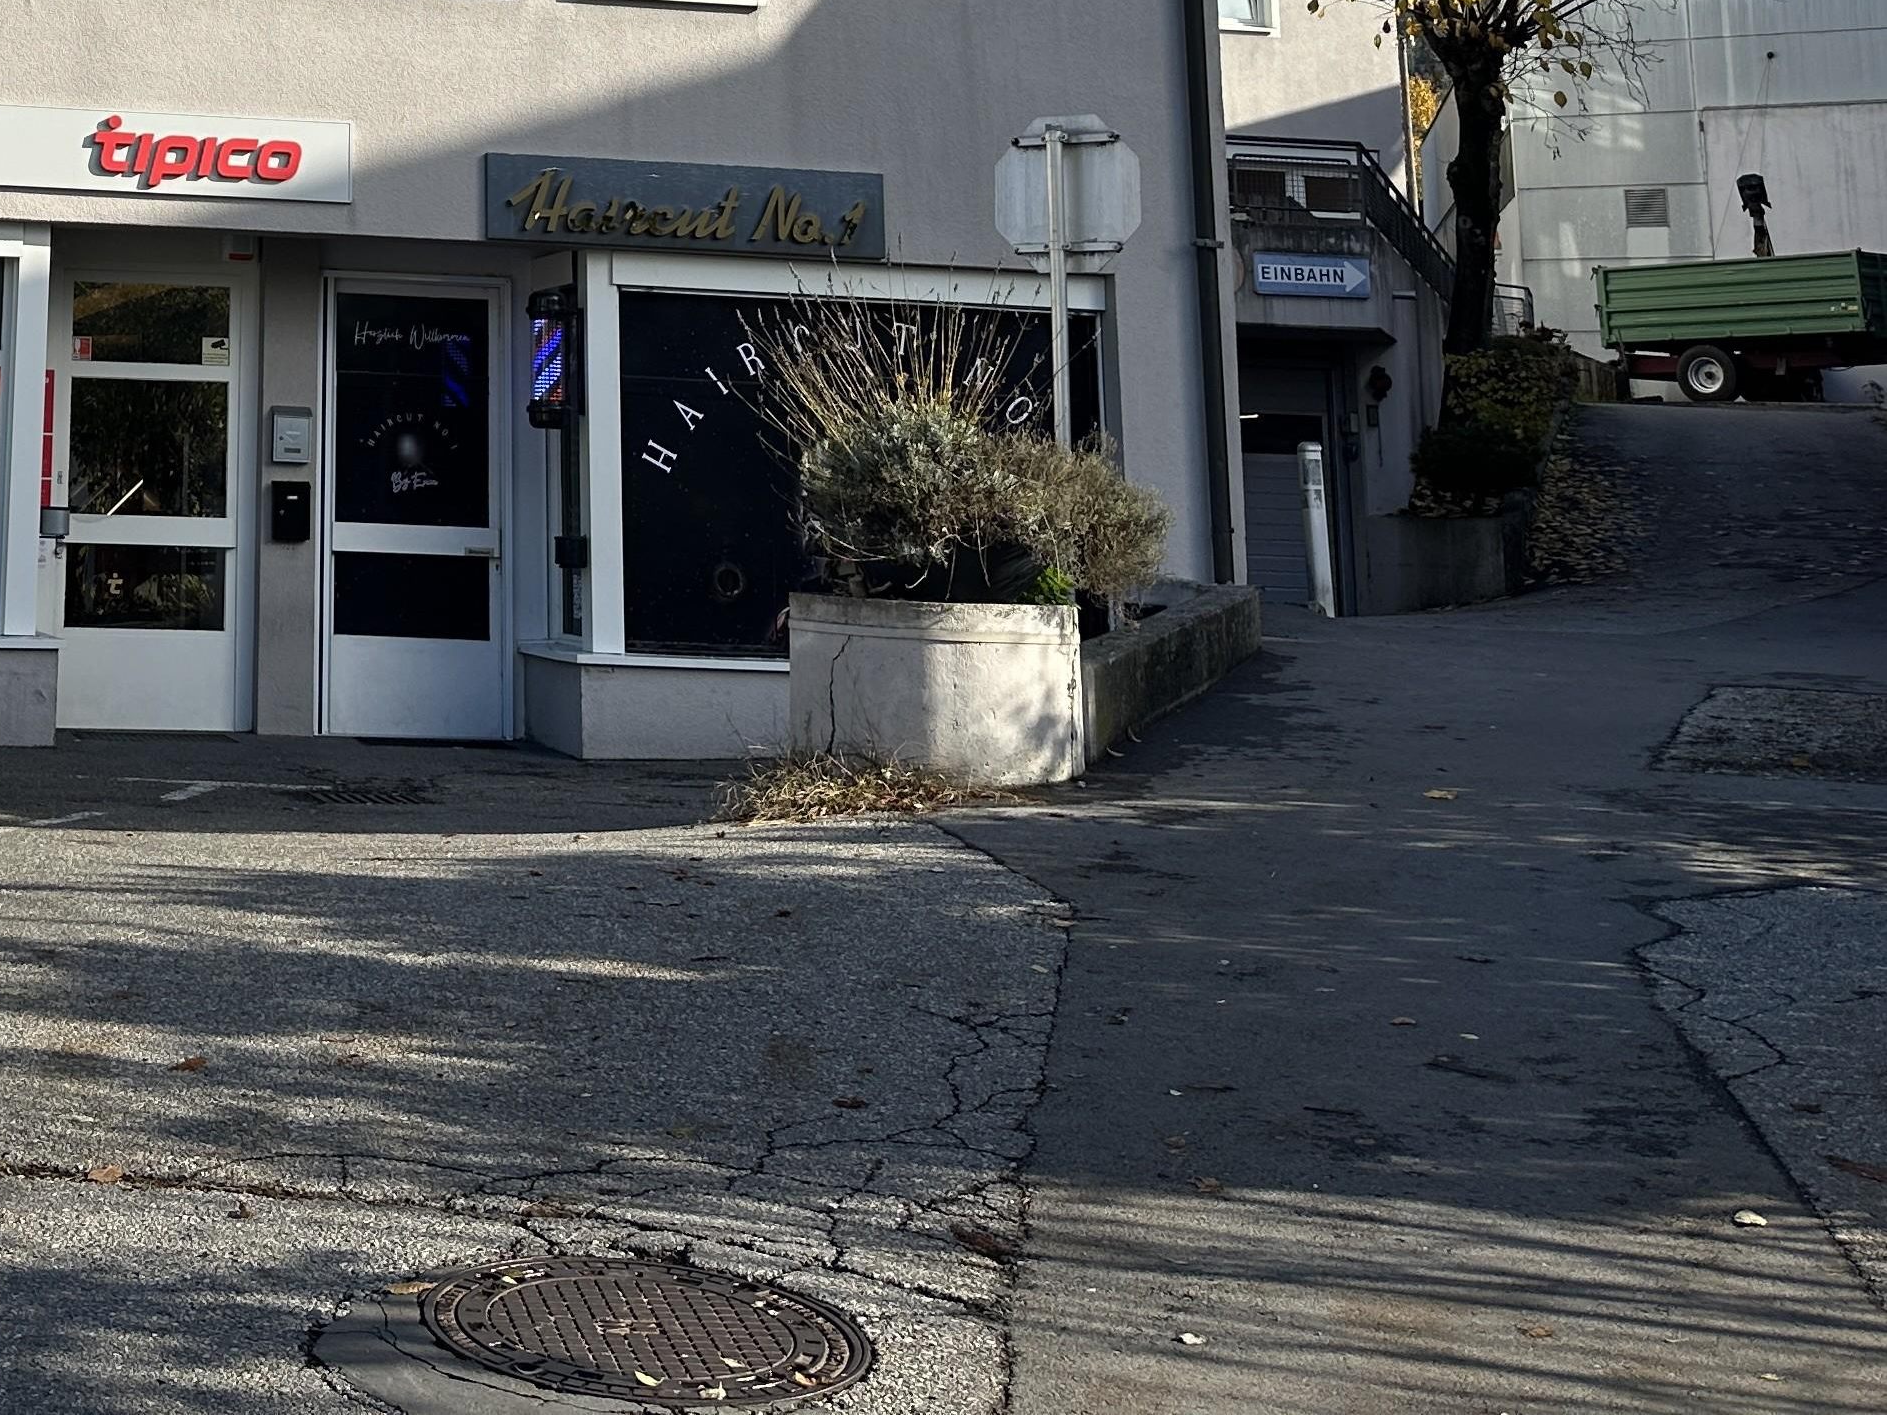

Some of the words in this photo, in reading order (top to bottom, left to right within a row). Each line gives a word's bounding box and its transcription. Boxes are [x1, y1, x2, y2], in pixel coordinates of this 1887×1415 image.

[92, 115, 303, 188] tipico
[506, 168, 741, 241] Haircut
[1260, 265, 1345, 284] EINBAHN
